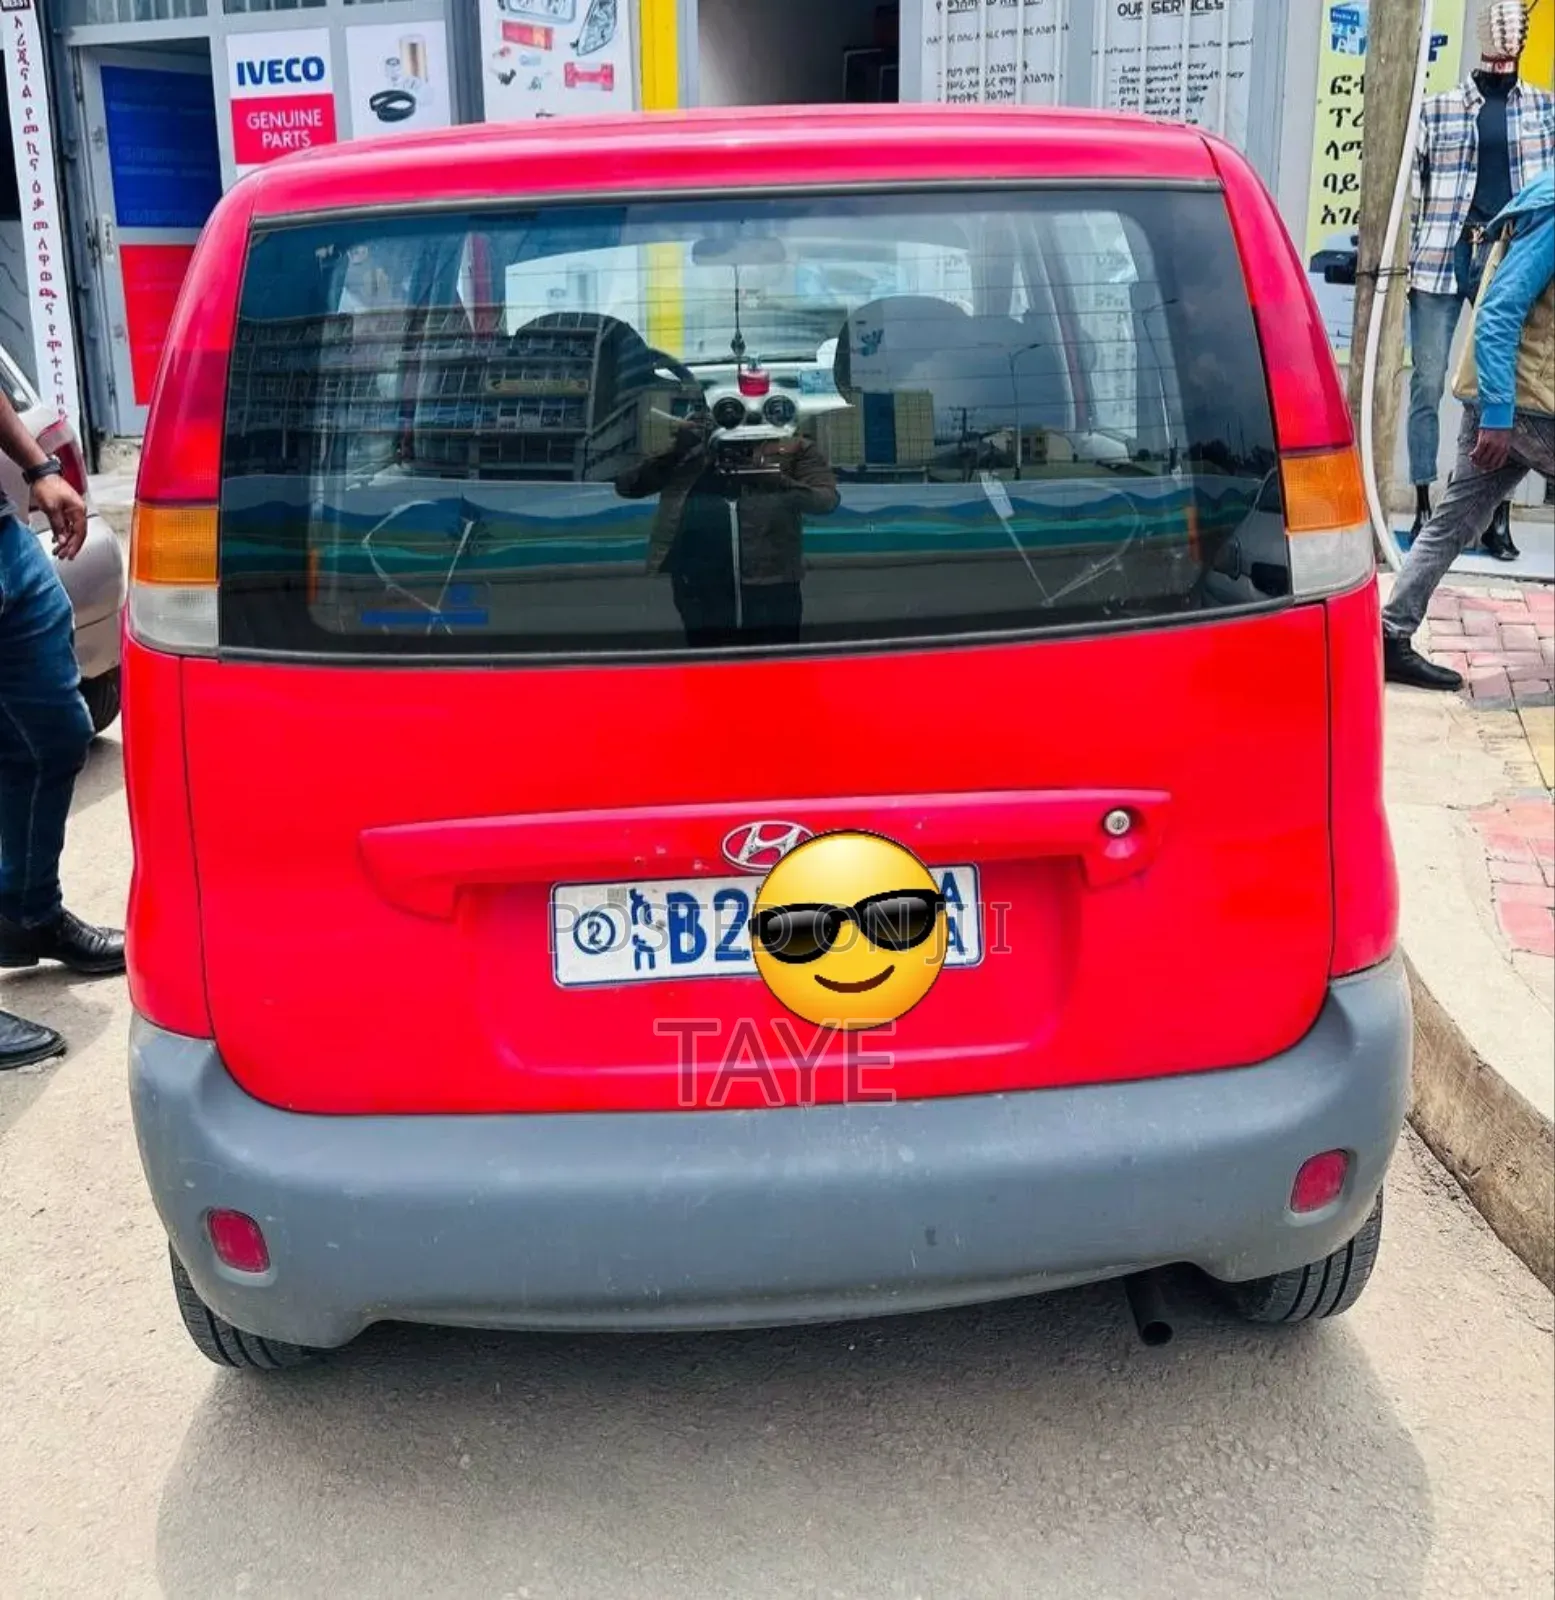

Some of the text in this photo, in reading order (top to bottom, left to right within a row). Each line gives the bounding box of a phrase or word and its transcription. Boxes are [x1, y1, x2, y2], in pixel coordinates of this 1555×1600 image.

[1151, 0, 1225, 15] SERICES
[237, 56, 326, 86] IVECO
[247, 108, 324, 132] GENUINE
[261, 129, 312, 149] PARTS
